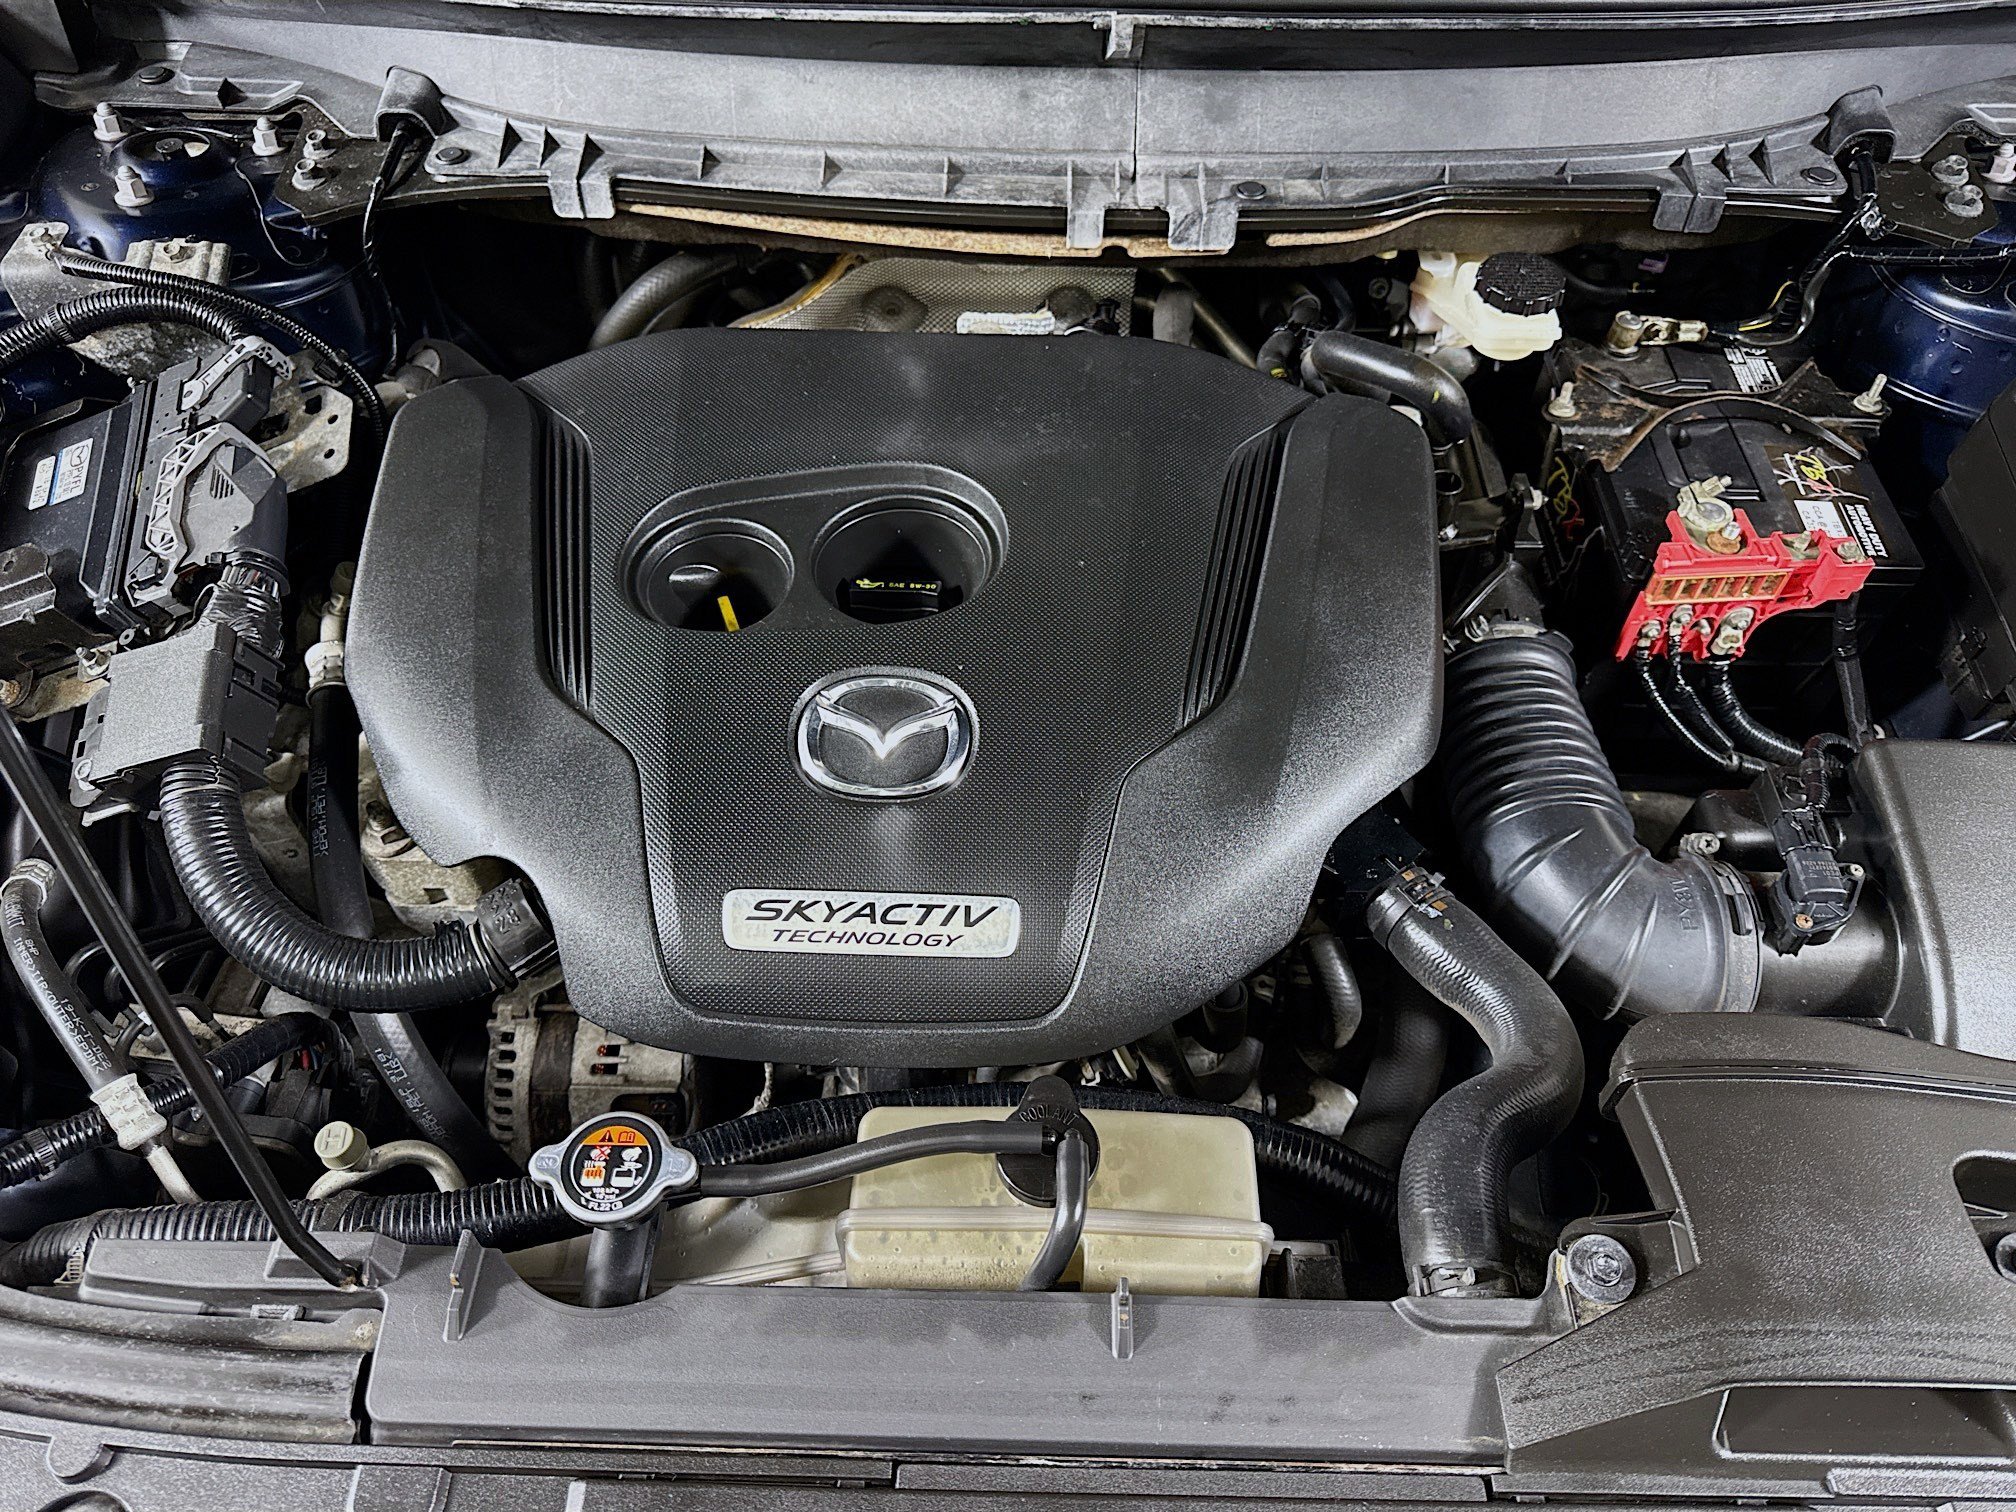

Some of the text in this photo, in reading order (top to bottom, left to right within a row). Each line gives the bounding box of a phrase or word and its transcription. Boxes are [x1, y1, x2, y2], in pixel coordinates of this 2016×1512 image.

[1845, 504, 1877, 557] AUTOMOTIVE
[1854, 504, 1889, 558] HEAVY DUTY
[744, 899, 999, 928] SKYACTIV
[771, 929, 965, 947] TECHNOLOGY
[1019, 1104, 1080, 1126] COOLANT
